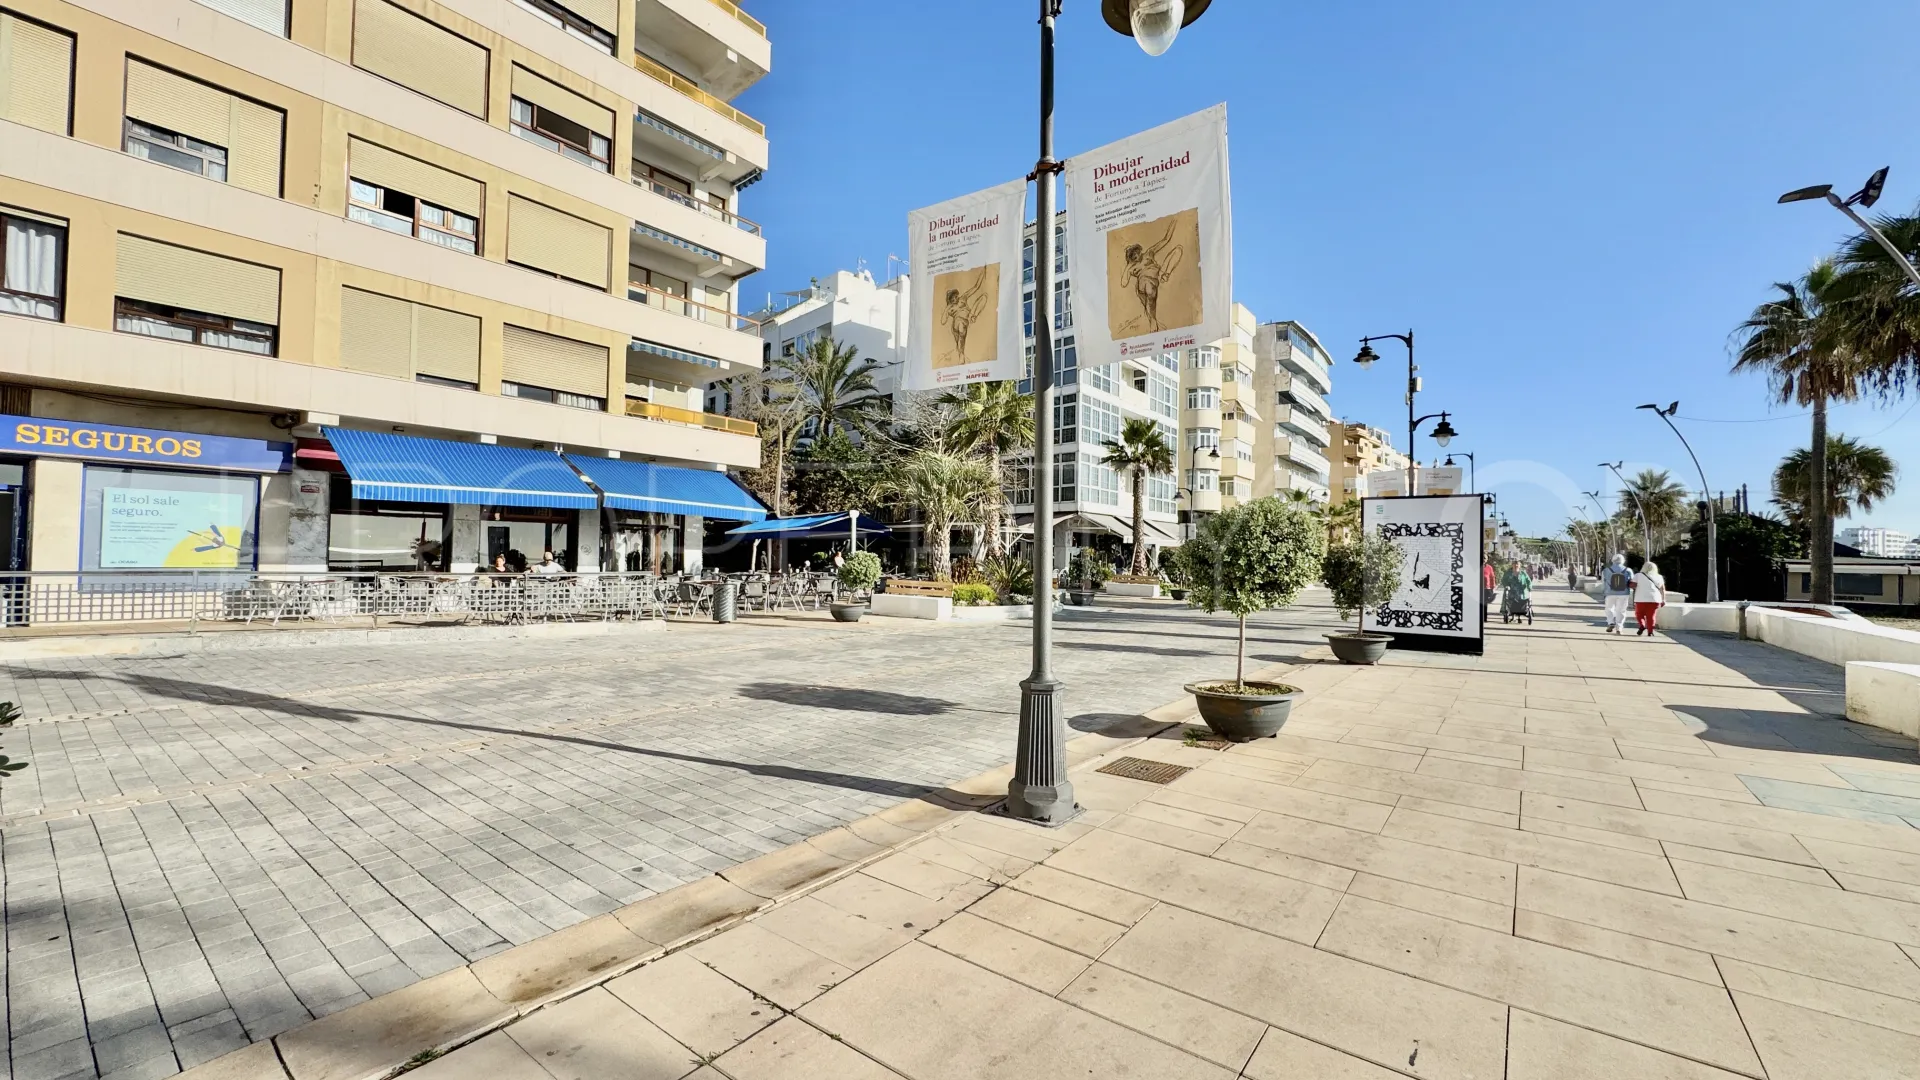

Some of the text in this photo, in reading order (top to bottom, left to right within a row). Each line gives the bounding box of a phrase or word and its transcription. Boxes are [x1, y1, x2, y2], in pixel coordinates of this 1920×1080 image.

[1093, 156, 1143, 180] Dibujar
[1094, 151, 1190, 193] la modernidad
[1094, 195, 1102, 203] de
[1105, 186, 1133, 200] Fortuny
[1105, 206, 1122, 217] Mirador
[1131, 198, 1151, 208] Carmen
[929, 215, 966, 232] Dibujar
[1095, 214, 1117, 225] Estepona
[928, 214, 999, 243] la modernidad
[1163, 338, 1195, 350] MAPFRE
[15, 423, 202, 458] SEGUROS
[112, 493, 180, 506] El sol sale
[111, 507, 163, 518] seguro.
